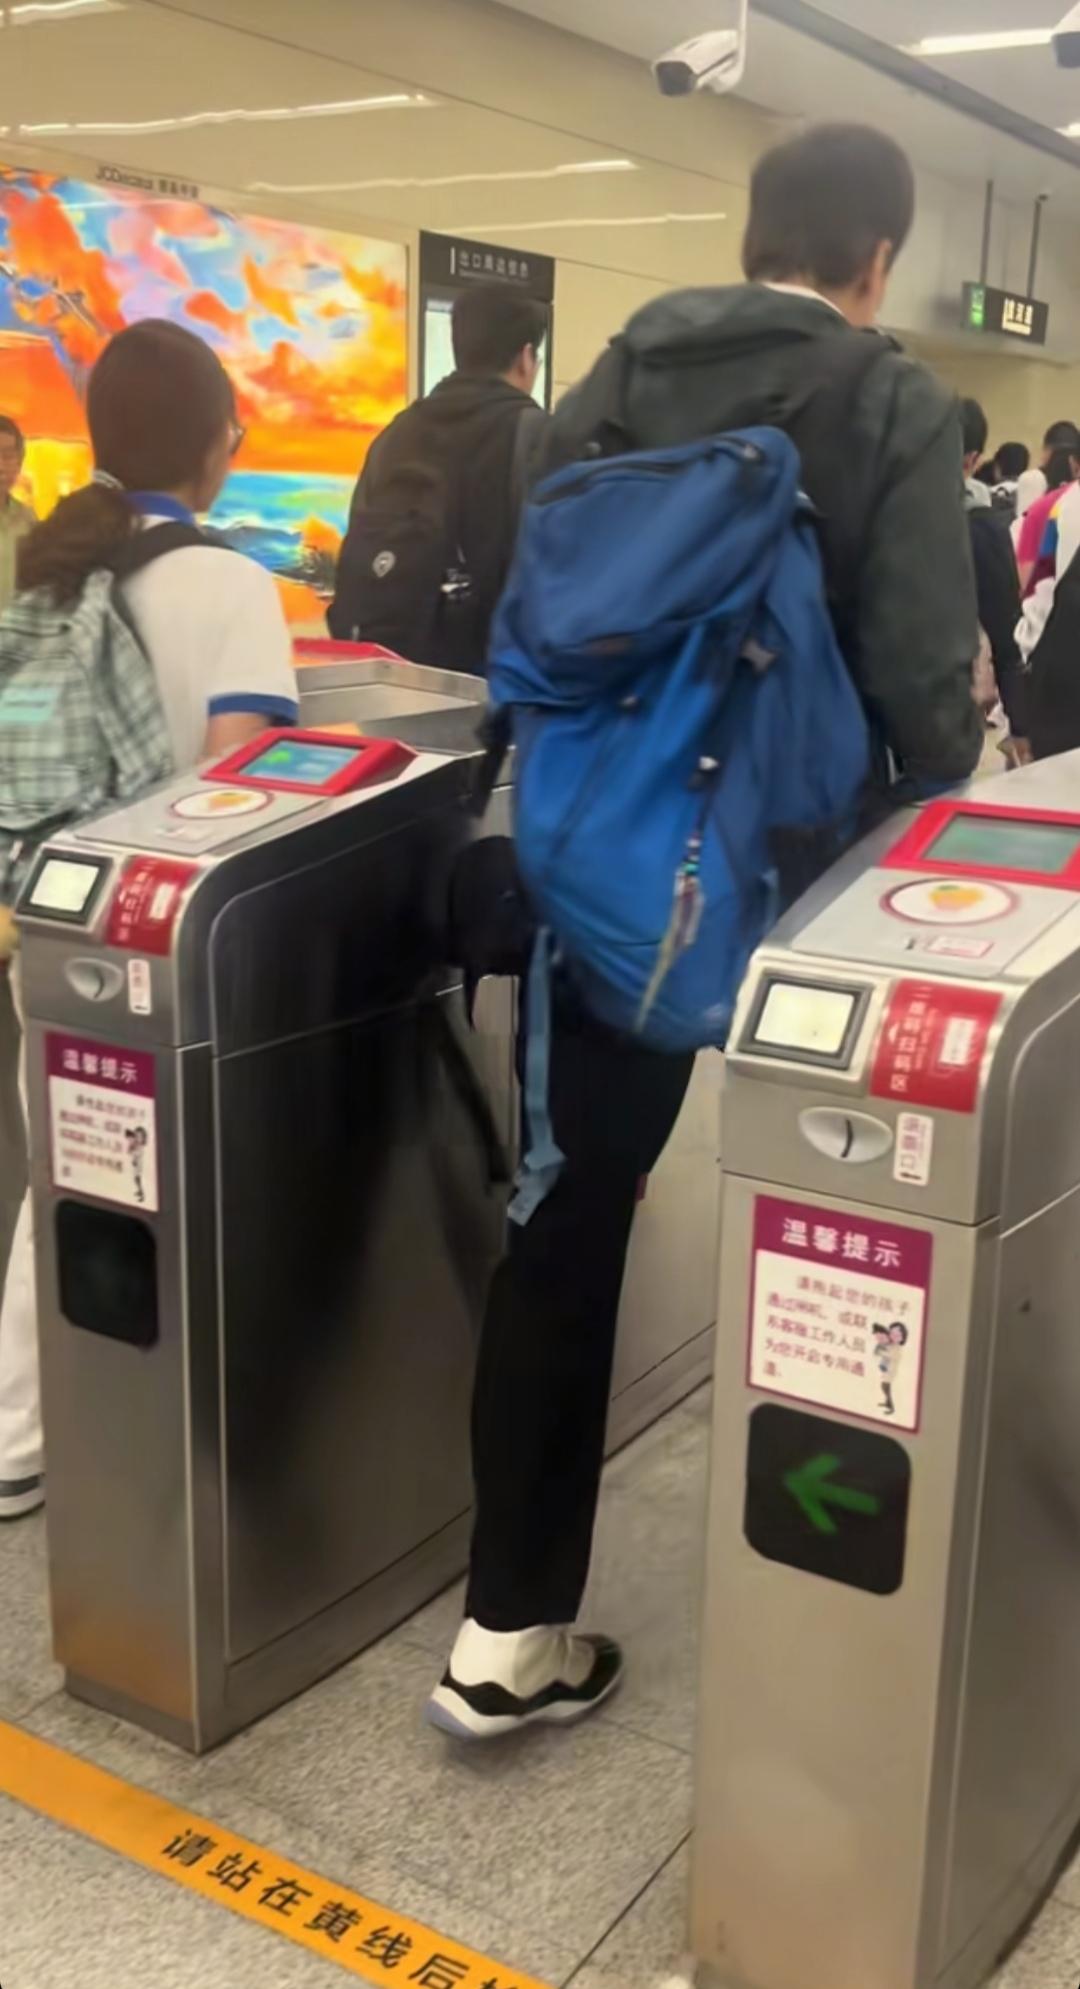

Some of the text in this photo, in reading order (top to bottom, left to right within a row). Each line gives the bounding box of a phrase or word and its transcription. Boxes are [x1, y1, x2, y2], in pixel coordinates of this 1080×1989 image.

[781, 1217, 901, 1267] 温馨提示
[161, 1829, 519, 1989] 请站在黄线后
